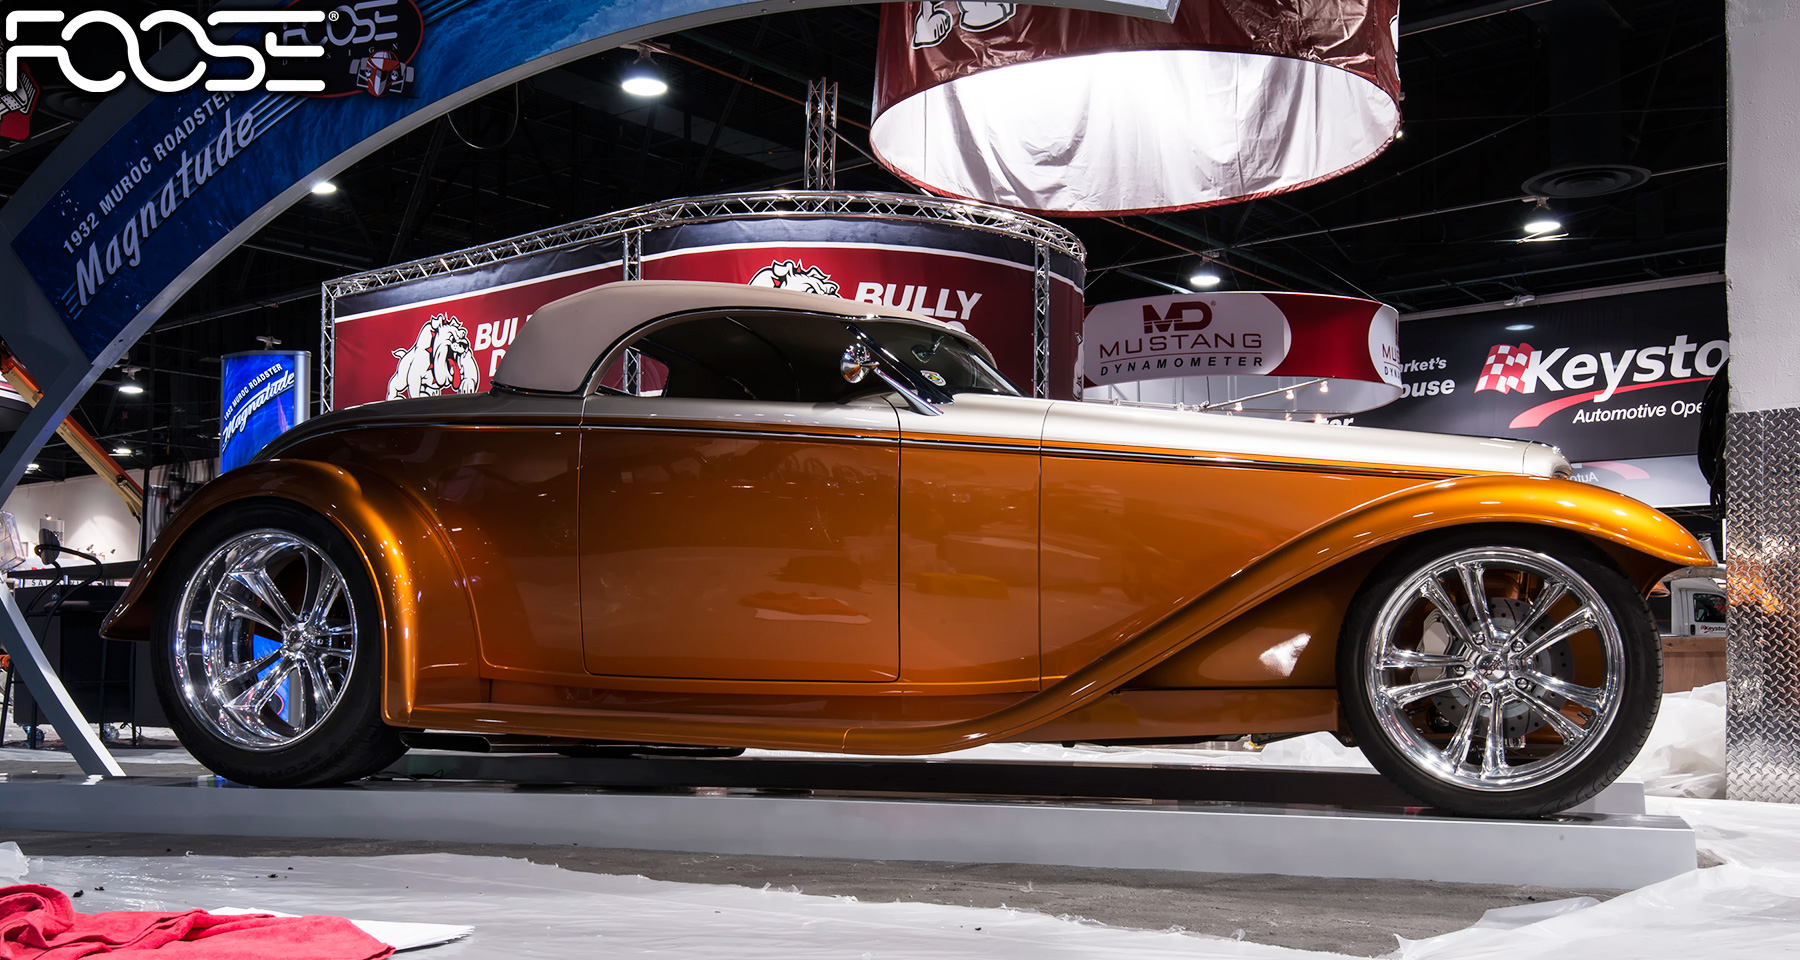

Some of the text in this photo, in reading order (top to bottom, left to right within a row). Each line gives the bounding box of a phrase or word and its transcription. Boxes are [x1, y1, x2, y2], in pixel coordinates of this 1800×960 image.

[63, 212, 100, 254] 1932
[98, 156, 152, 216] MUROC
[76, 107, 255, 306] Magnatude
[854, 281, 983, 320] BULLY
[1099, 332, 1263, 359] MUSTANG
[1100, 356, 1264, 377] DYNAMOMETER
[231, 386, 250, 406] MUROC
[248, 362, 284, 389] ROADSTER
[1522, 334, 1730, 403] Keysto
[222, 369, 295, 443] Magnatude
[1572, 403, 1667, 424] Automotive
